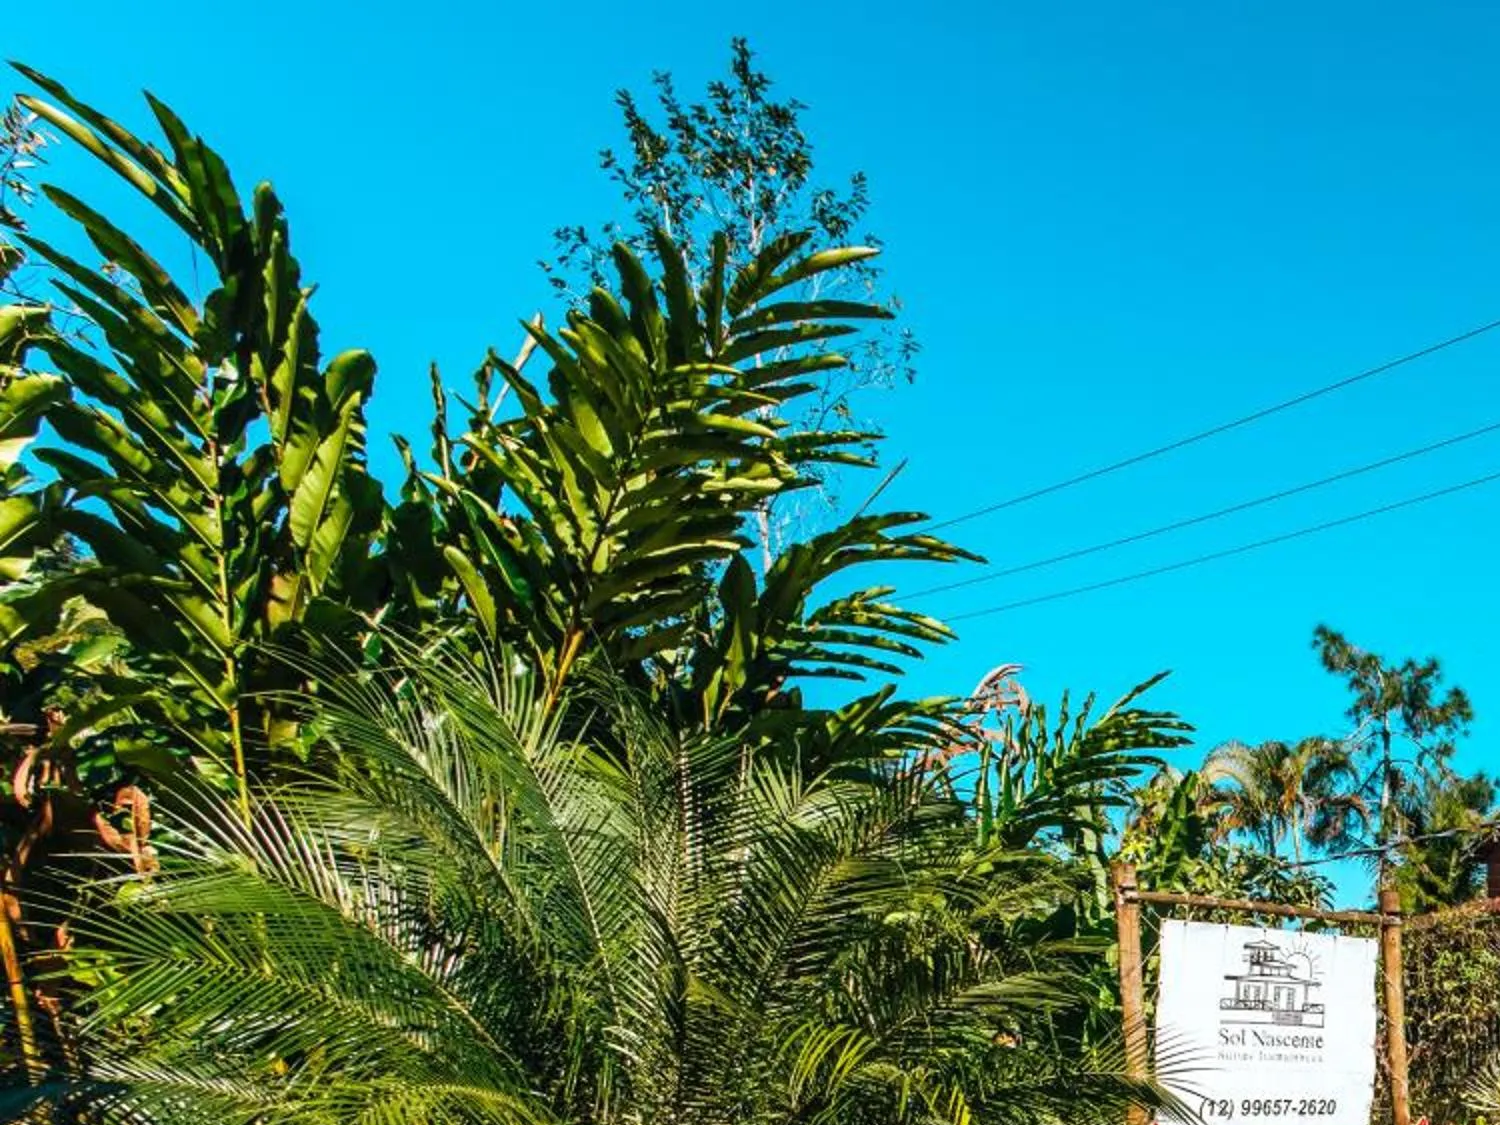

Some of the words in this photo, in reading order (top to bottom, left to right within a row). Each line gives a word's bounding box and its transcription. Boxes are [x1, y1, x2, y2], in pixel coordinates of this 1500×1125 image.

[1219, 1027, 1245, 1046] Sol
[1200, 1099, 1234, 1120] (12)
[1241, 1099, 1337, 1117] 99657-2620
